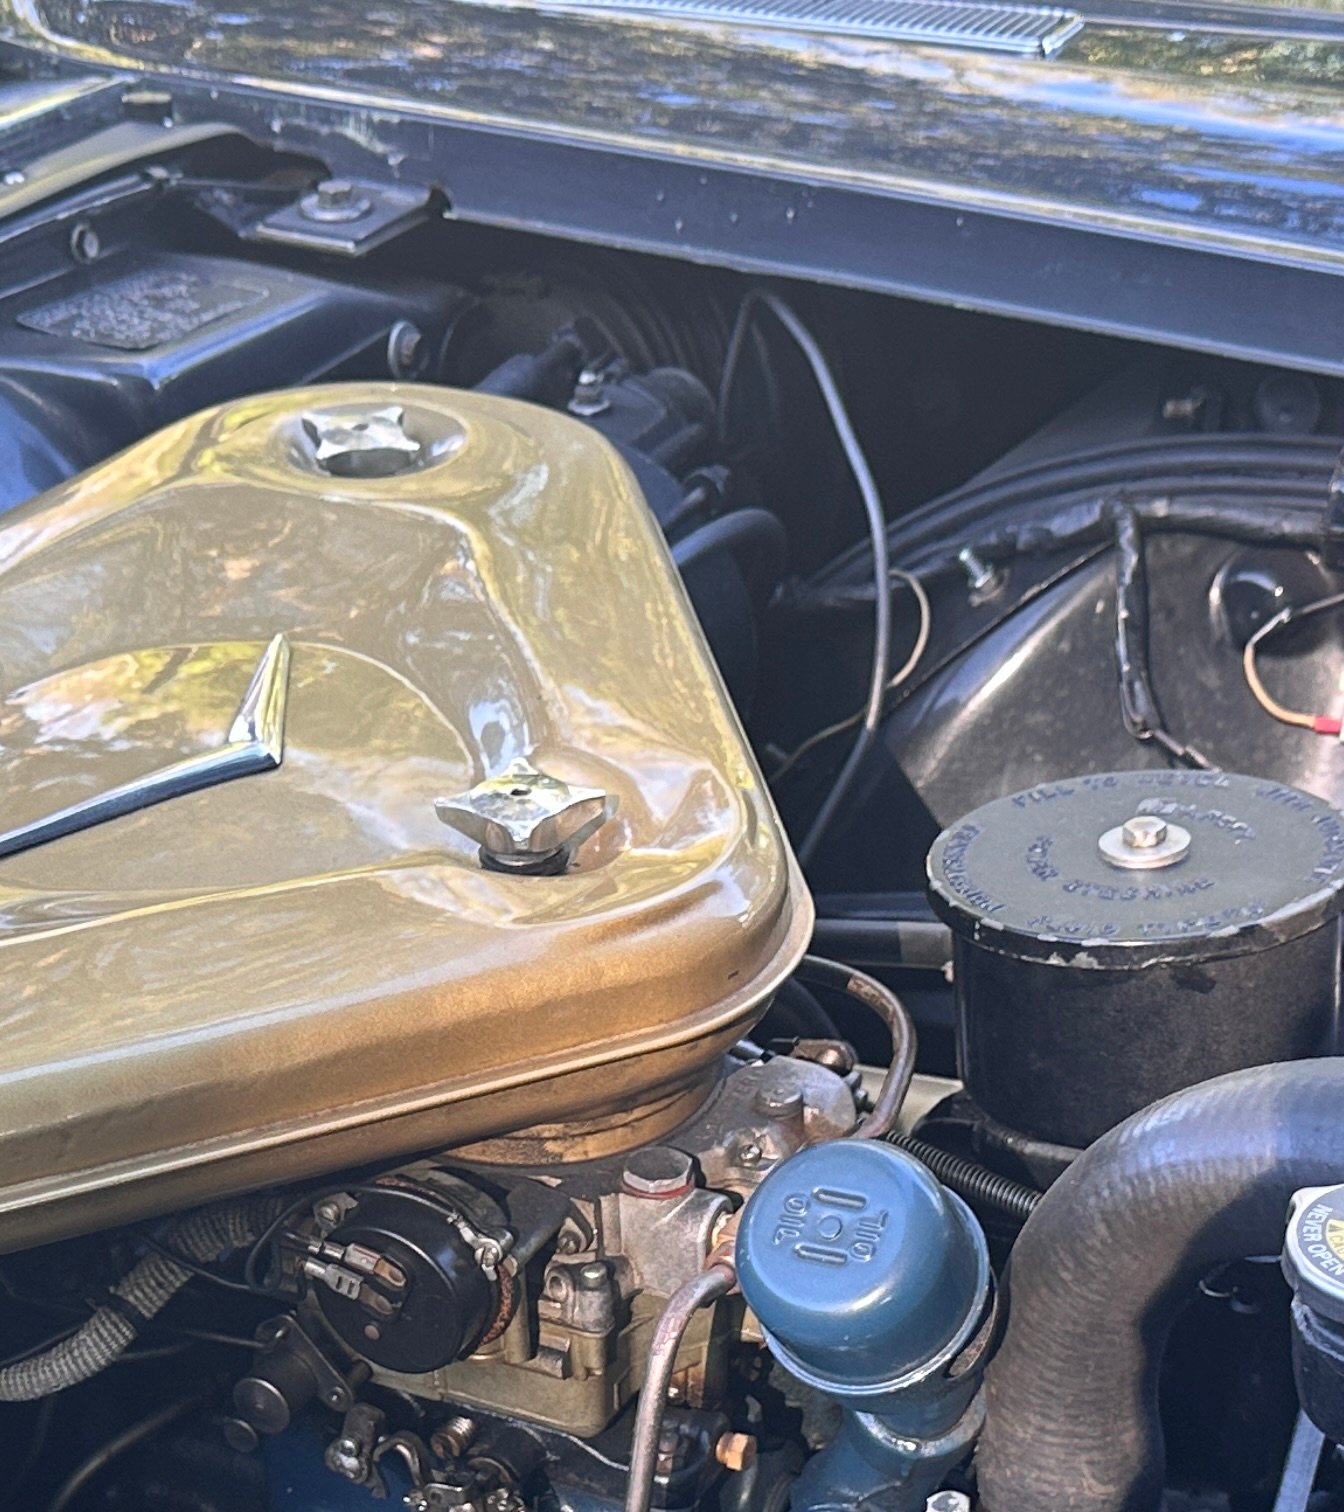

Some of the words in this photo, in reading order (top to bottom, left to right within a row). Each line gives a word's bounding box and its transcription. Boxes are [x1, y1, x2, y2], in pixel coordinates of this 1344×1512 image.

[773, 1195, 808, 1245] OIL
[850, 1209, 889, 1263] OIL
[1303, 1204, 1333, 1242] NEVER
